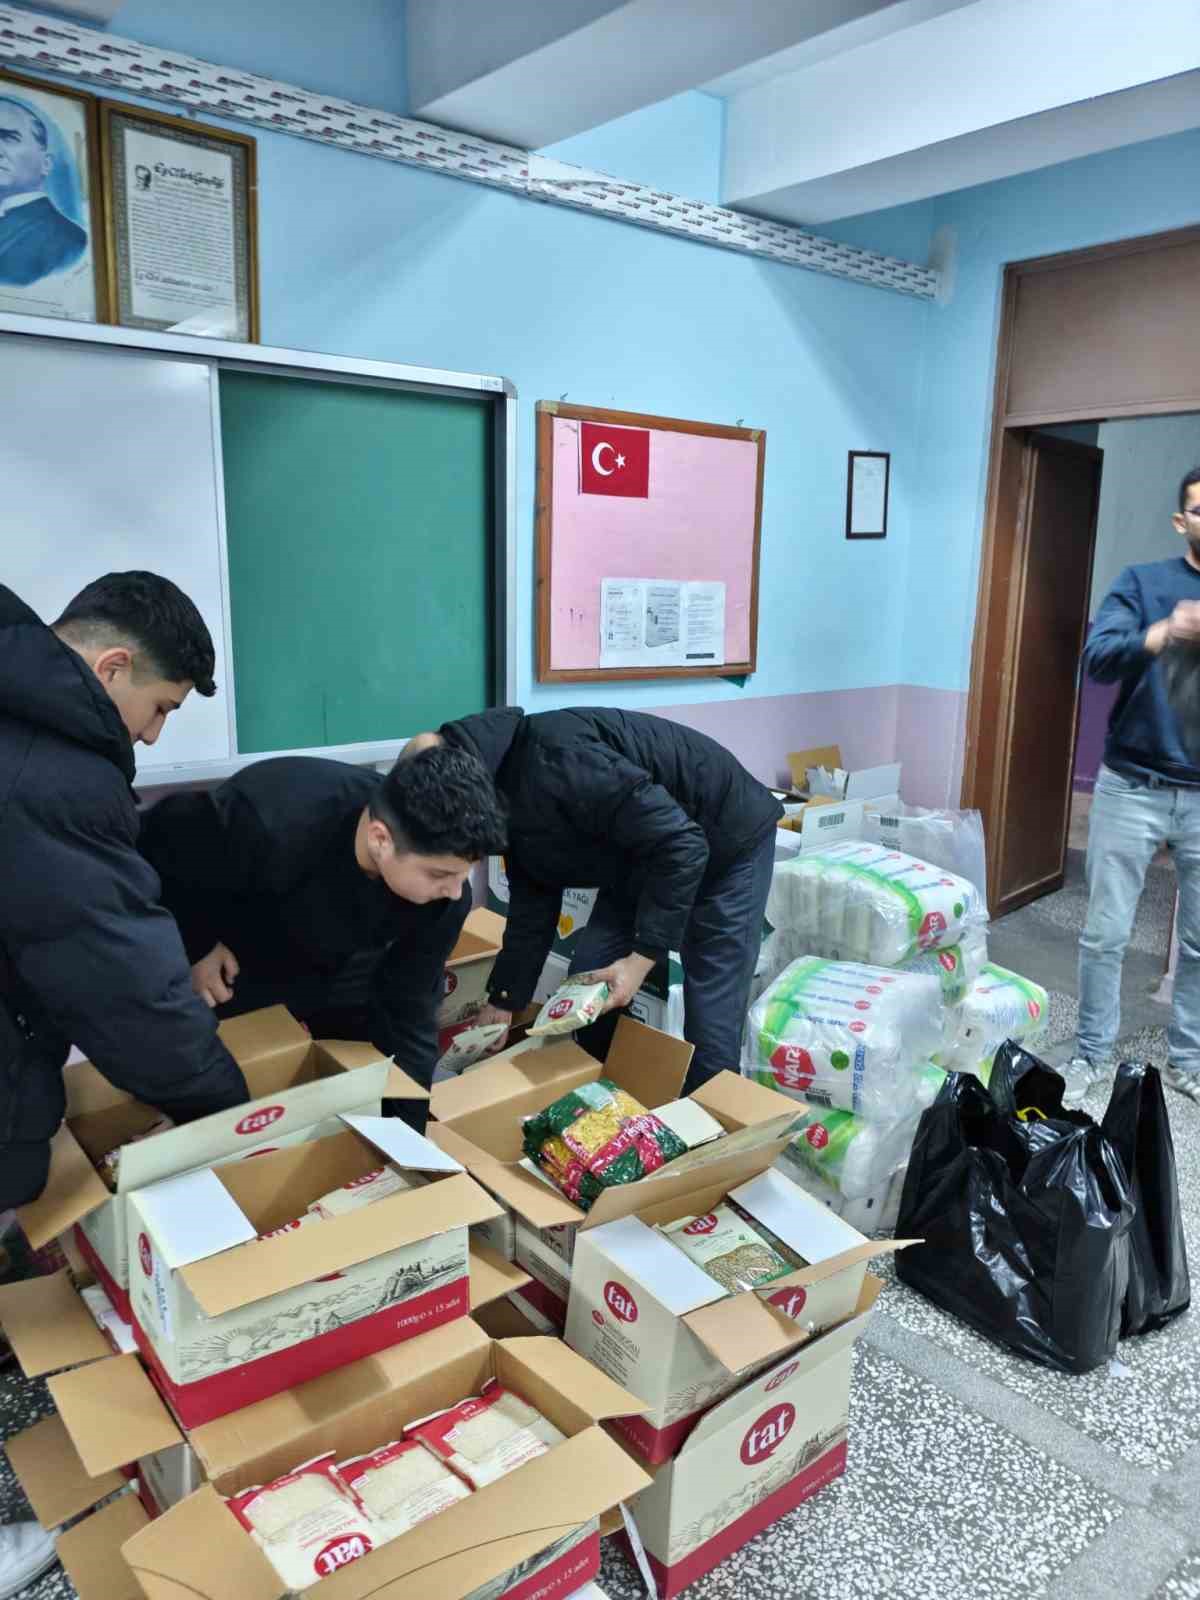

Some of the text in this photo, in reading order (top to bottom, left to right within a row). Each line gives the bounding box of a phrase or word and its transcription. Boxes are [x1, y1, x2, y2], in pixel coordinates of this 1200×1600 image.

[687, 1215, 716, 1233] tat
[608, 1285, 636, 1321] tat
[748, 1408, 790, 1458] tat
